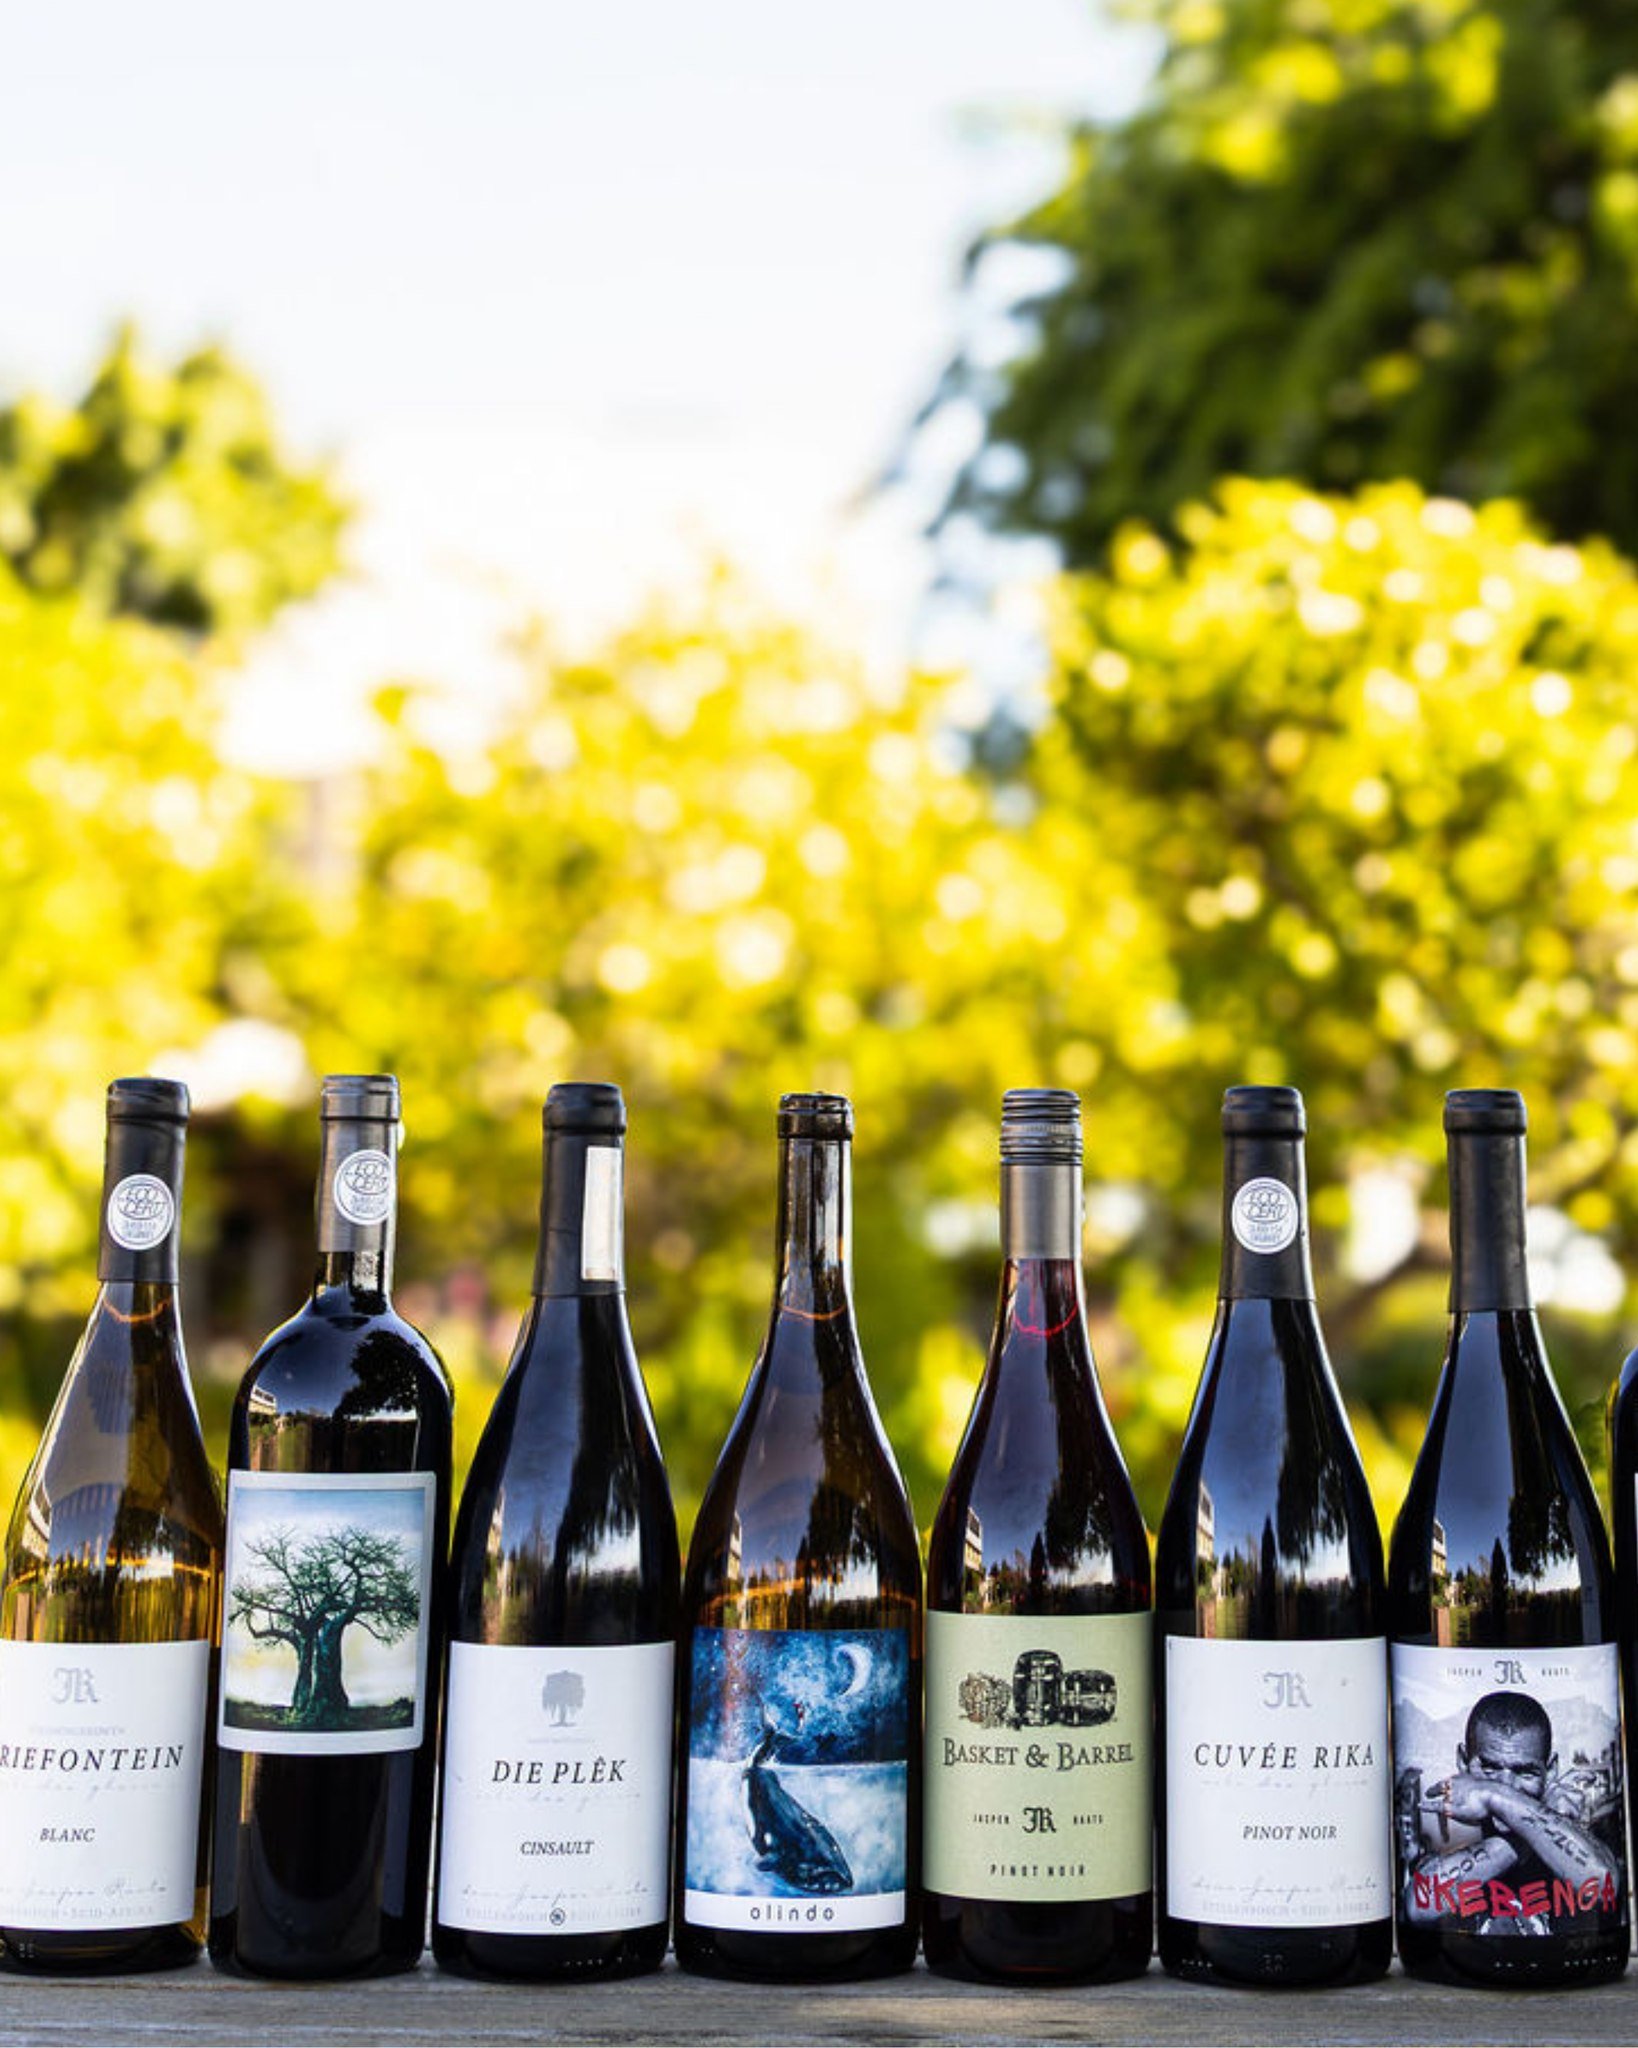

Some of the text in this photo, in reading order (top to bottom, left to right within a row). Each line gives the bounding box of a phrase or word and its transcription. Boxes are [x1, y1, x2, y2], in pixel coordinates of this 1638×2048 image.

[1025, 1744, 1050, 1768] &
[1194, 1742, 1374, 1769] CUVÉE RIKA
[492, 1755, 626, 1784] DIE PLÊK
[40, 1828, 95, 1842] BLANC
[1243, 1825, 1337, 1840] PINOT NOIR
[520, 1841, 594, 1856] CINSAULT
[991, 1864, 1085, 1877] PINOT NOIR
[1413, 1870, 1617, 1918] SKEBENGA
[750, 1904, 834, 1921] olindo
